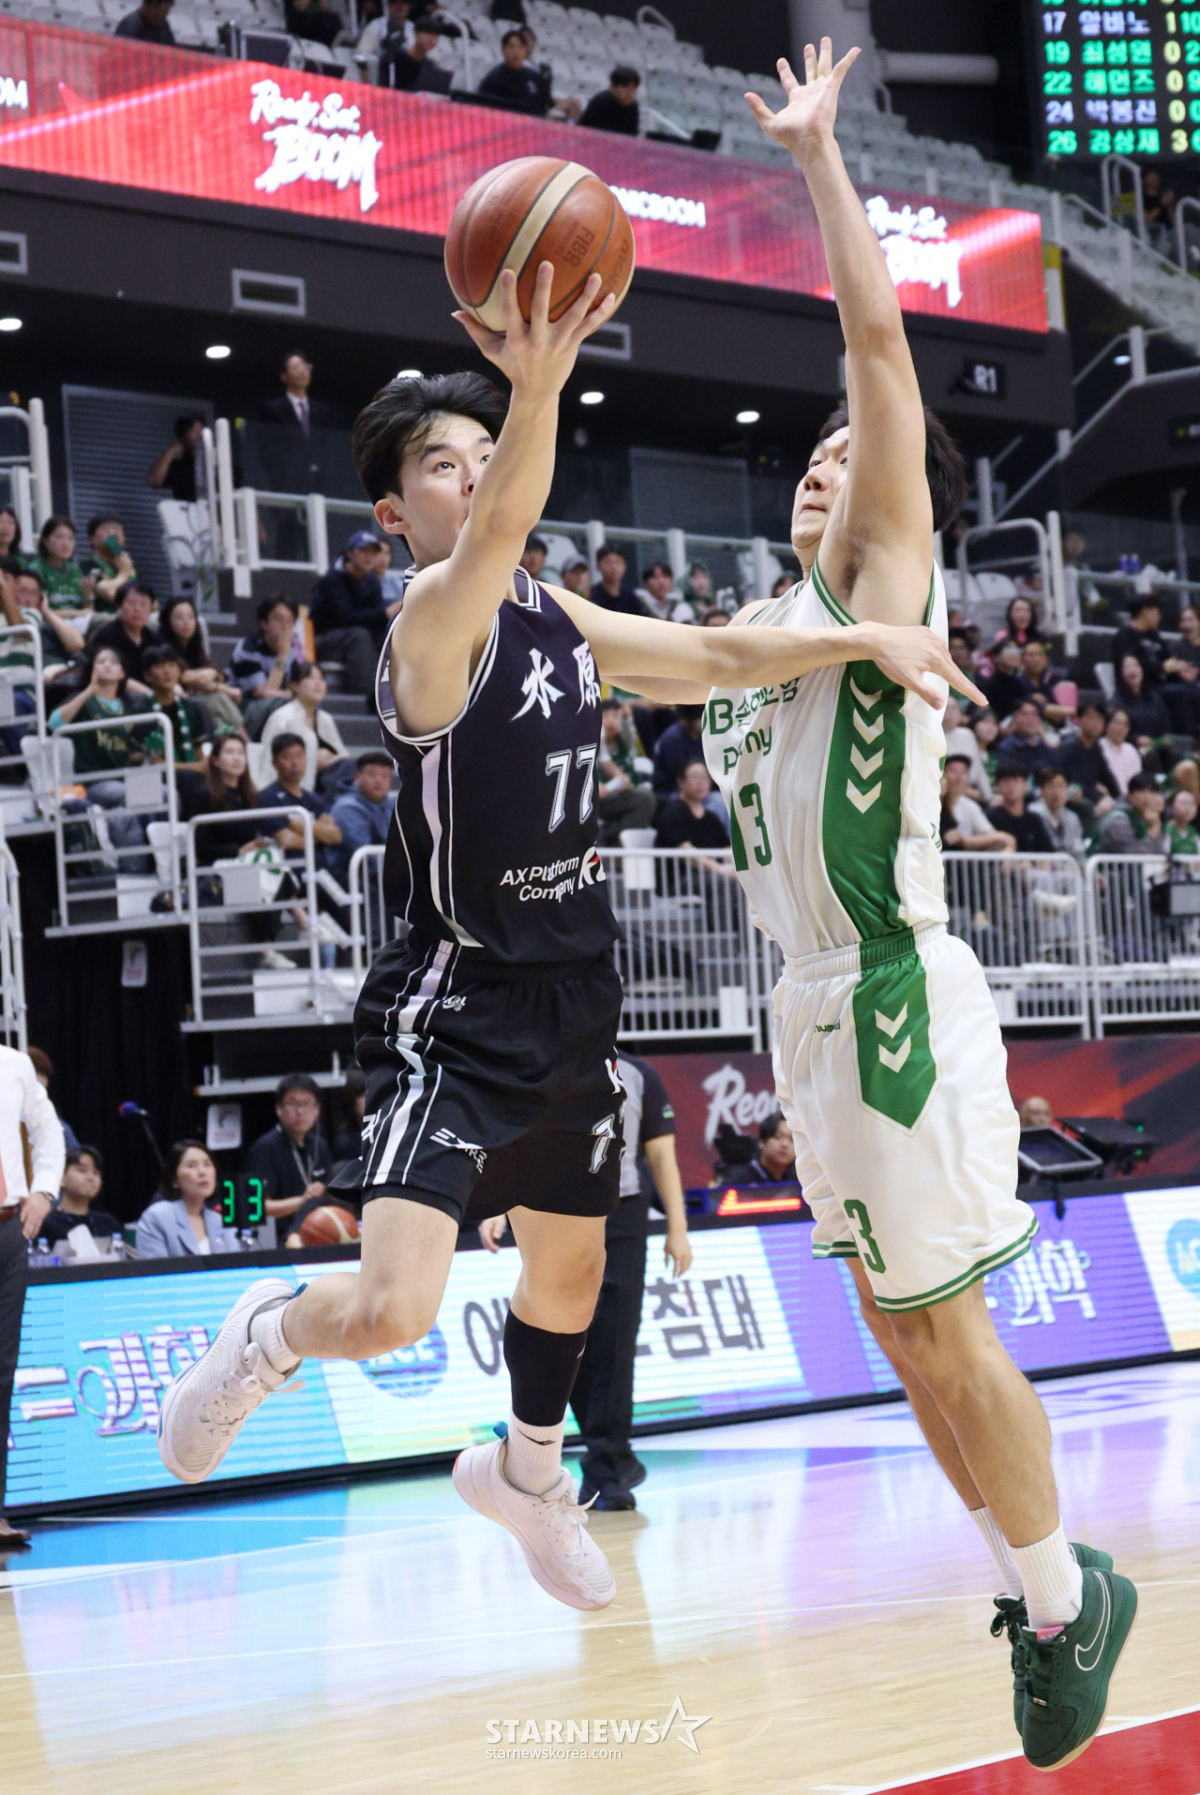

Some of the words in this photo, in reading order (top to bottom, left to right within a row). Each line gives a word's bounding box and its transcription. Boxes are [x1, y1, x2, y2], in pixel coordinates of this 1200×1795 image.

[1043, 10, 1067, 35] 17
[1165, 11, 1176, 34] 1
[1045, 40, 1070, 65] 19
[1164, 40, 1181, 64] 0
[1184, 40, 1200, 65] 2
[1043, 70, 1073, 95] 22
[1166, 69, 1183, 93] 0
[1046, 100, 1074, 124] 24
[1168, 99, 1186, 123] 0
[1048, 130, 1077, 154] 26
[1171, 129, 1188, 153] 3
[254, 124, 383, 212] BOOM
[545, 743, 597, 833] 77
[499, 868, 529, 886] AX
[529, 856, 580, 882] Platform
[519, 876, 575, 903] Company
[844, 1199, 886, 1274] 3
